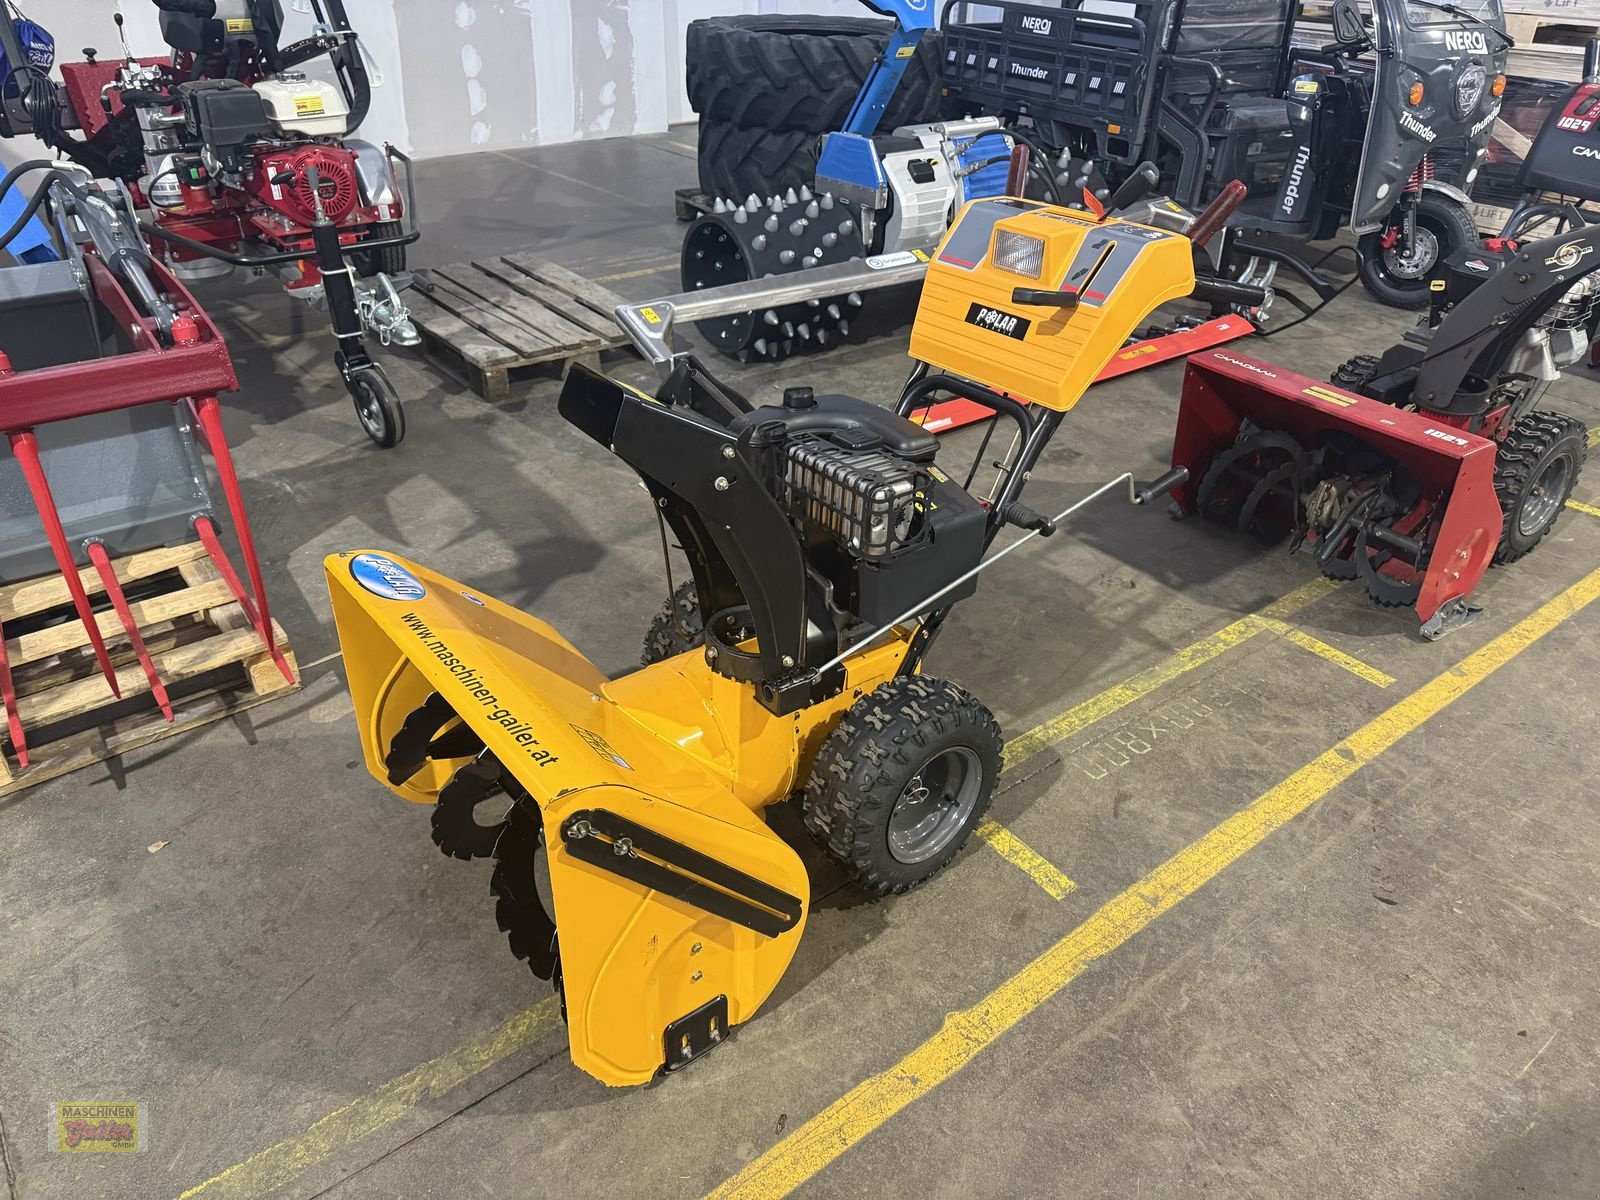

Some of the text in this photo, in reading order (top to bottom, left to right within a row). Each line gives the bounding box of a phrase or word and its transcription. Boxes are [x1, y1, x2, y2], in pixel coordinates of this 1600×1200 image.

[1021, 16, 1051, 33] NERO
[1445, 31, 1485, 53] NERO
[1011, 63, 1048, 79] Thunder
[1399, 111, 1438, 142] Thunder
[1557, 116, 1592, 131] 1029
[1281, 145, 1311, 215] Thunder
[1480, 208, 1505, 220] LIFT
[401, 612, 559, 767] www.maschinen-gailer.at
